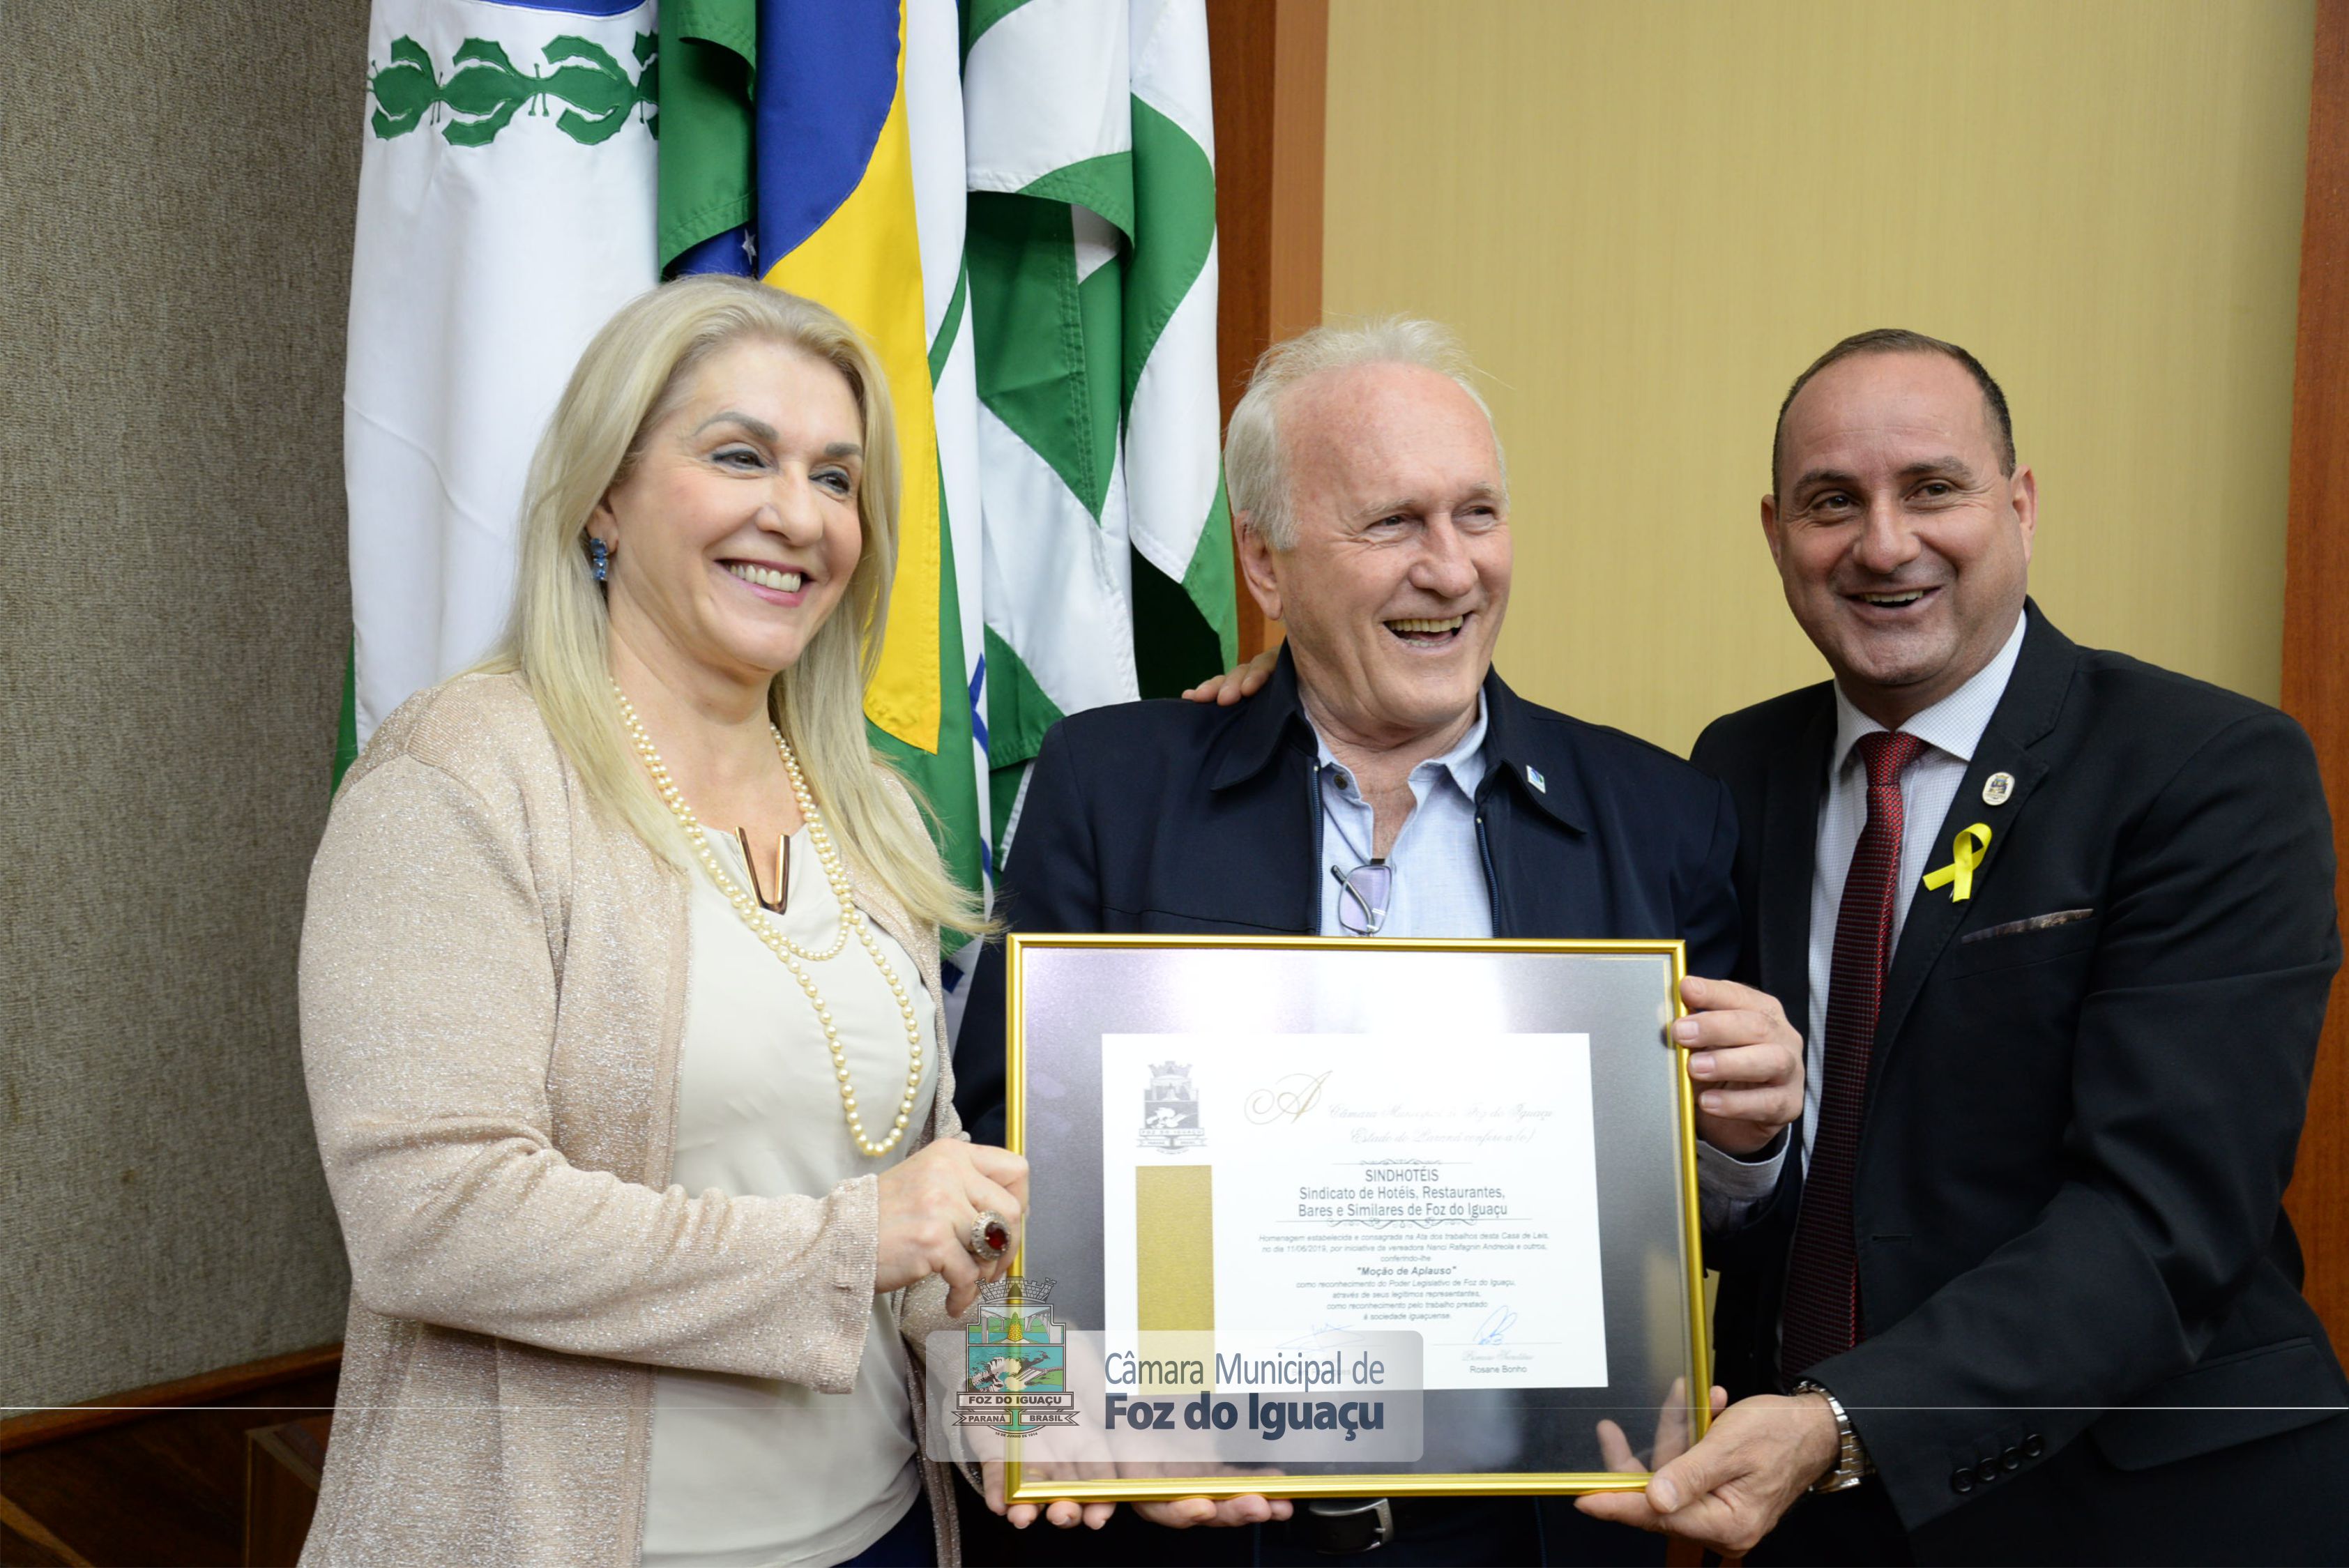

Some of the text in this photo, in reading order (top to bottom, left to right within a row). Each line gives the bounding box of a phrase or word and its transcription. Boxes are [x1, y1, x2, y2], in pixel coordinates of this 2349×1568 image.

[1365, 1166, 1439, 1182] SINDHOTÉIS
[1299, 1186, 1505, 1201] Sindicato de Hotéis, Restaurantes,
[1299, 1203, 1507, 1219] Bares e Similares de Foz do Iguaçu
[1361, 1234, 1403, 1242] consagrada
[1357, 1266, 1457, 1277] "Moção de Aplauso"
[1412, 1279, 1450, 1288] Legislativo
[1469, 1364, 1528, 1373] Rosane Bonho
